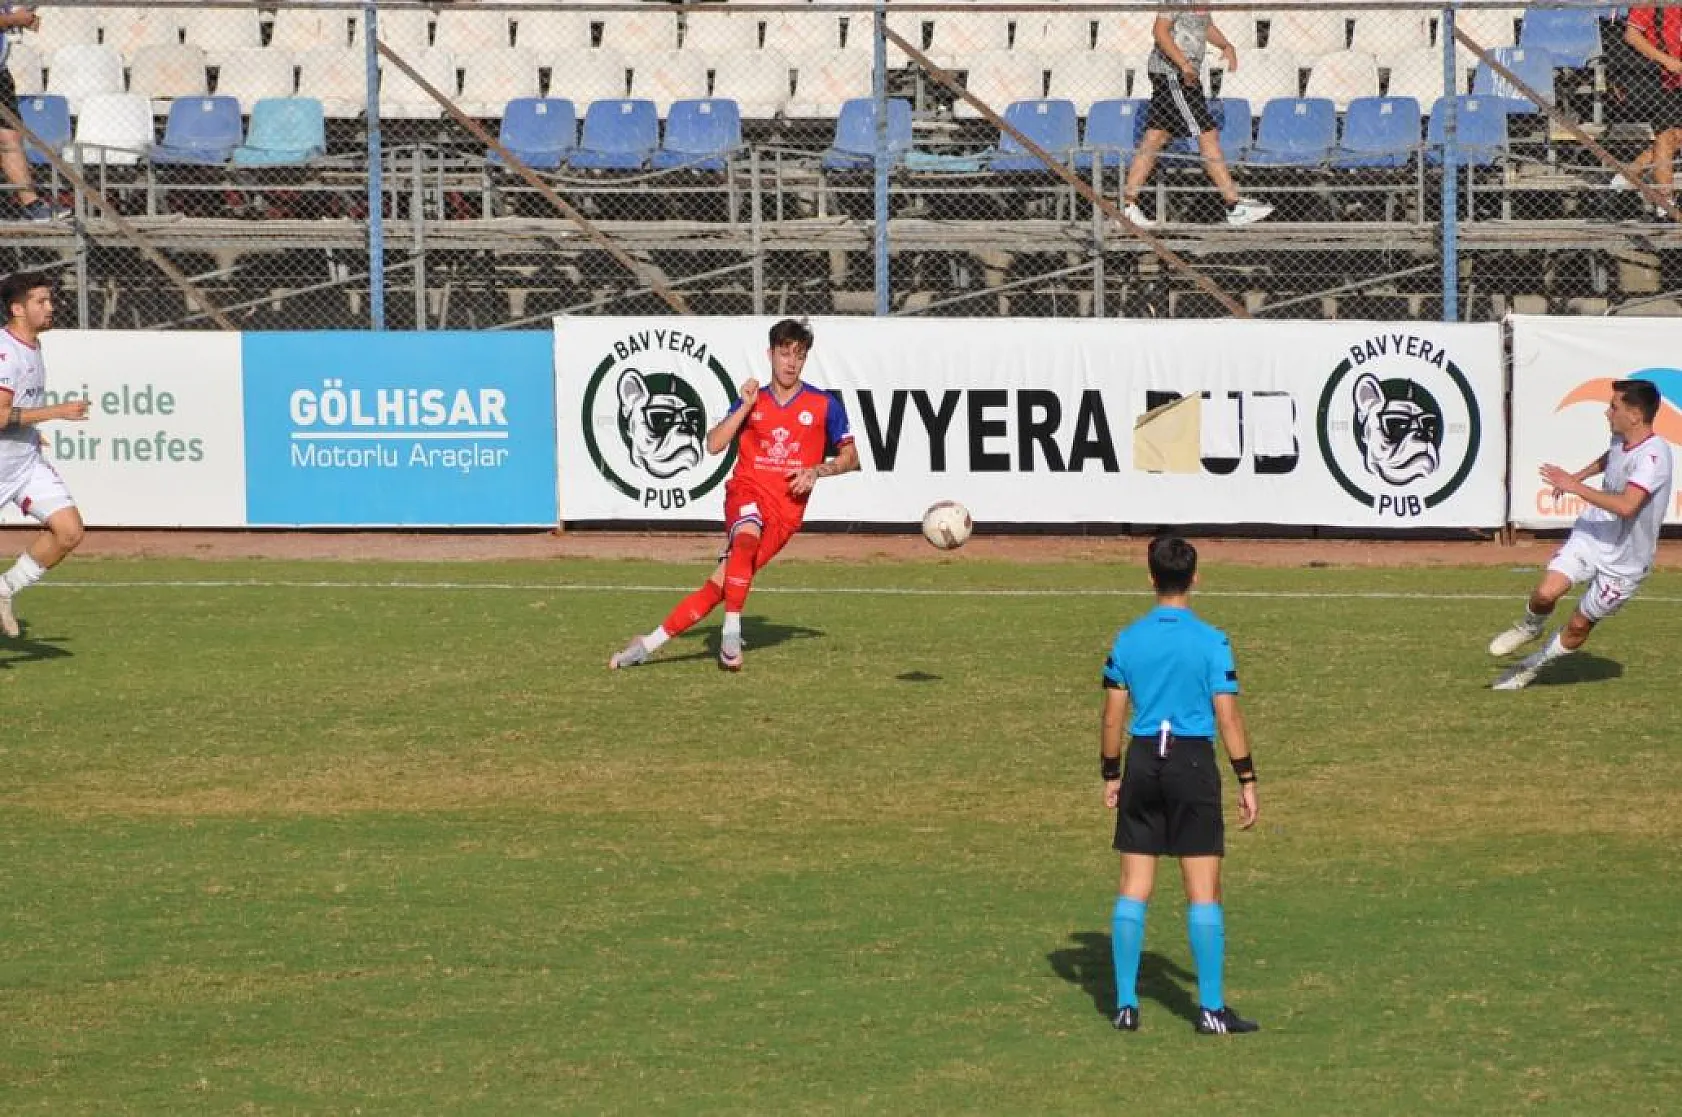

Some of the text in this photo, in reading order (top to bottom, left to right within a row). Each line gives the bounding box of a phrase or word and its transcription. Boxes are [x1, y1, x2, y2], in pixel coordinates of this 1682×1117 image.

[613, 328, 708, 364] BAVYERA
[1349, 333, 1446, 369] BAVYERA
[100, 383, 176, 416] elde
[54, 429, 205, 462] bir nefes
[822, 388, 1121, 472] VYERA
[290, 442, 509, 473] Motorlu Araçlar
[644, 487, 687, 510] PUB
[1378, 494, 1422, 517] PUB
